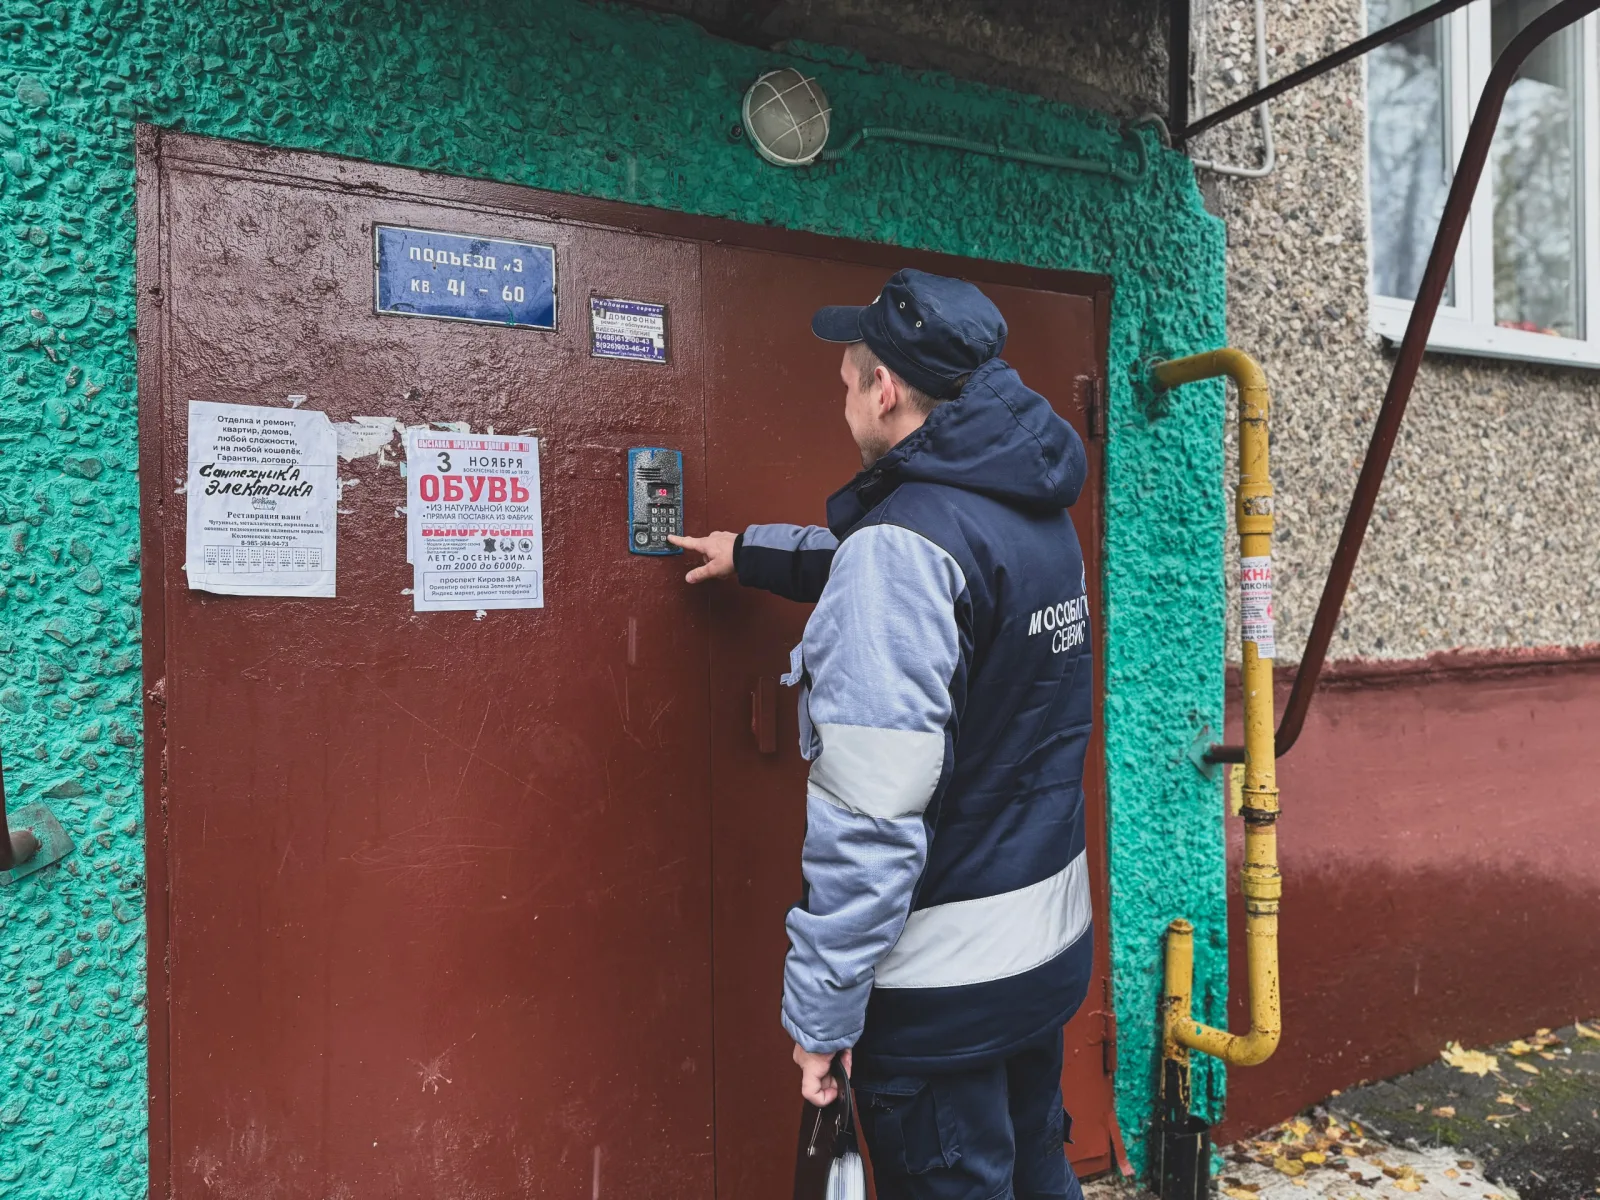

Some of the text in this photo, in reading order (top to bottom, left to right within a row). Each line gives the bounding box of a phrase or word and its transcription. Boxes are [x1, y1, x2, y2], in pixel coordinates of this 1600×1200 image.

[409, 247, 497, 270] ПОДЪЕЗД
[411, 279, 435, 294] КВ.
[447, 279, 465, 296] 41
[502, 285, 525, 302] 60
[608, 313, 656, 324] ДОМОФОНЫ
[217, 415, 254, 424] Отделка
[263, 419, 297, 427] ремонт,
[222, 427, 260, 435] квартир,
[217, 435, 298, 446] любой сложности,
[418, 439, 450, 449] ВЫСТАВКА
[453, 440, 481, 450] ПРОДАЖА
[264, 446, 303, 455] кошелёк.
[217, 453, 299, 465] Гарантия, договор.
[437, 452, 523, 473] 3 НОЯБРЯ
[420, 474, 530, 503] ОБУВЬ
[445, 503, 502, 512] НАТУРАЛЬНОЙ
[504, 505, 529, 513] КОЖИ
[227, 511, 279, 521] Реставрация
[421, 523, 534, 537] БЕЛОРУССИИ
[454, 562, 477, 570] 2000
[480, 562, 492, 570] до
[494, 562, 525, 571] 6000р.
[477, 576, 505, 584] Кирова
[1240, 568, 1272, 581] КНА
